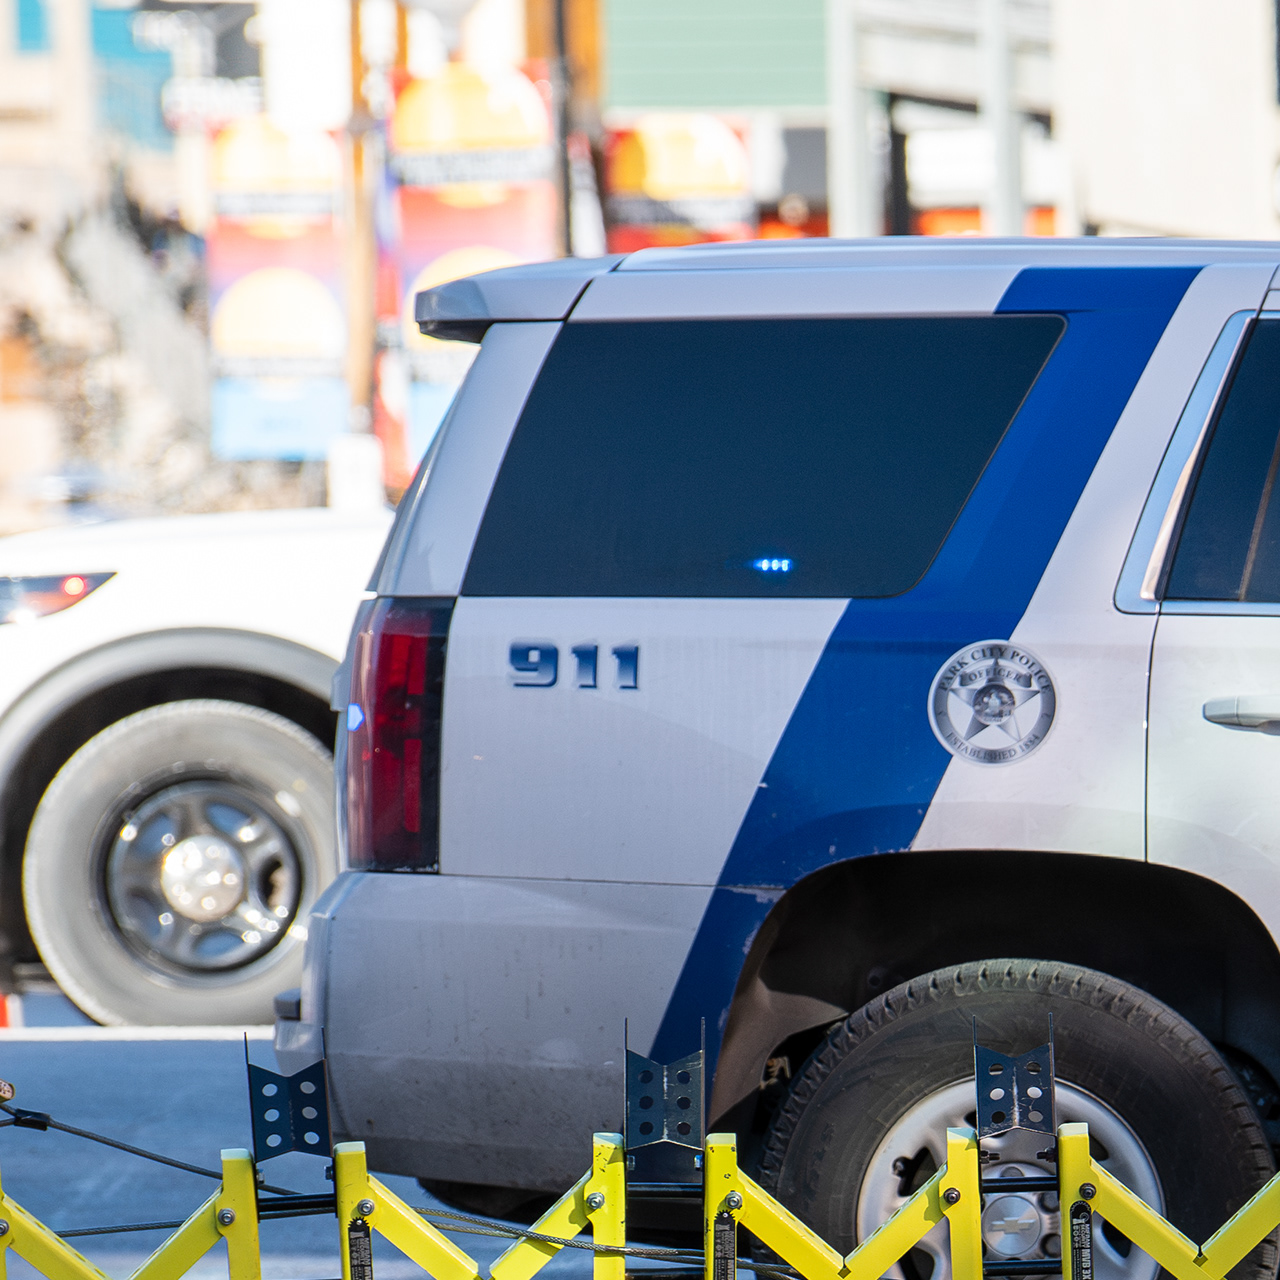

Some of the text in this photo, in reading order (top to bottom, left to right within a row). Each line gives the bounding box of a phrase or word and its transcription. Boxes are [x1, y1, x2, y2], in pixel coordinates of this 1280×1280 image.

[508, 640, 639, 690] 911
[939, 647, 1051, 692] PARK CITY POLICE
[969, 668, 1020, 682] OFFICER
[945, 732, 1016, 760] ESTABLISHED
[1082, 1249, 1091, 1280] MVB 3X
